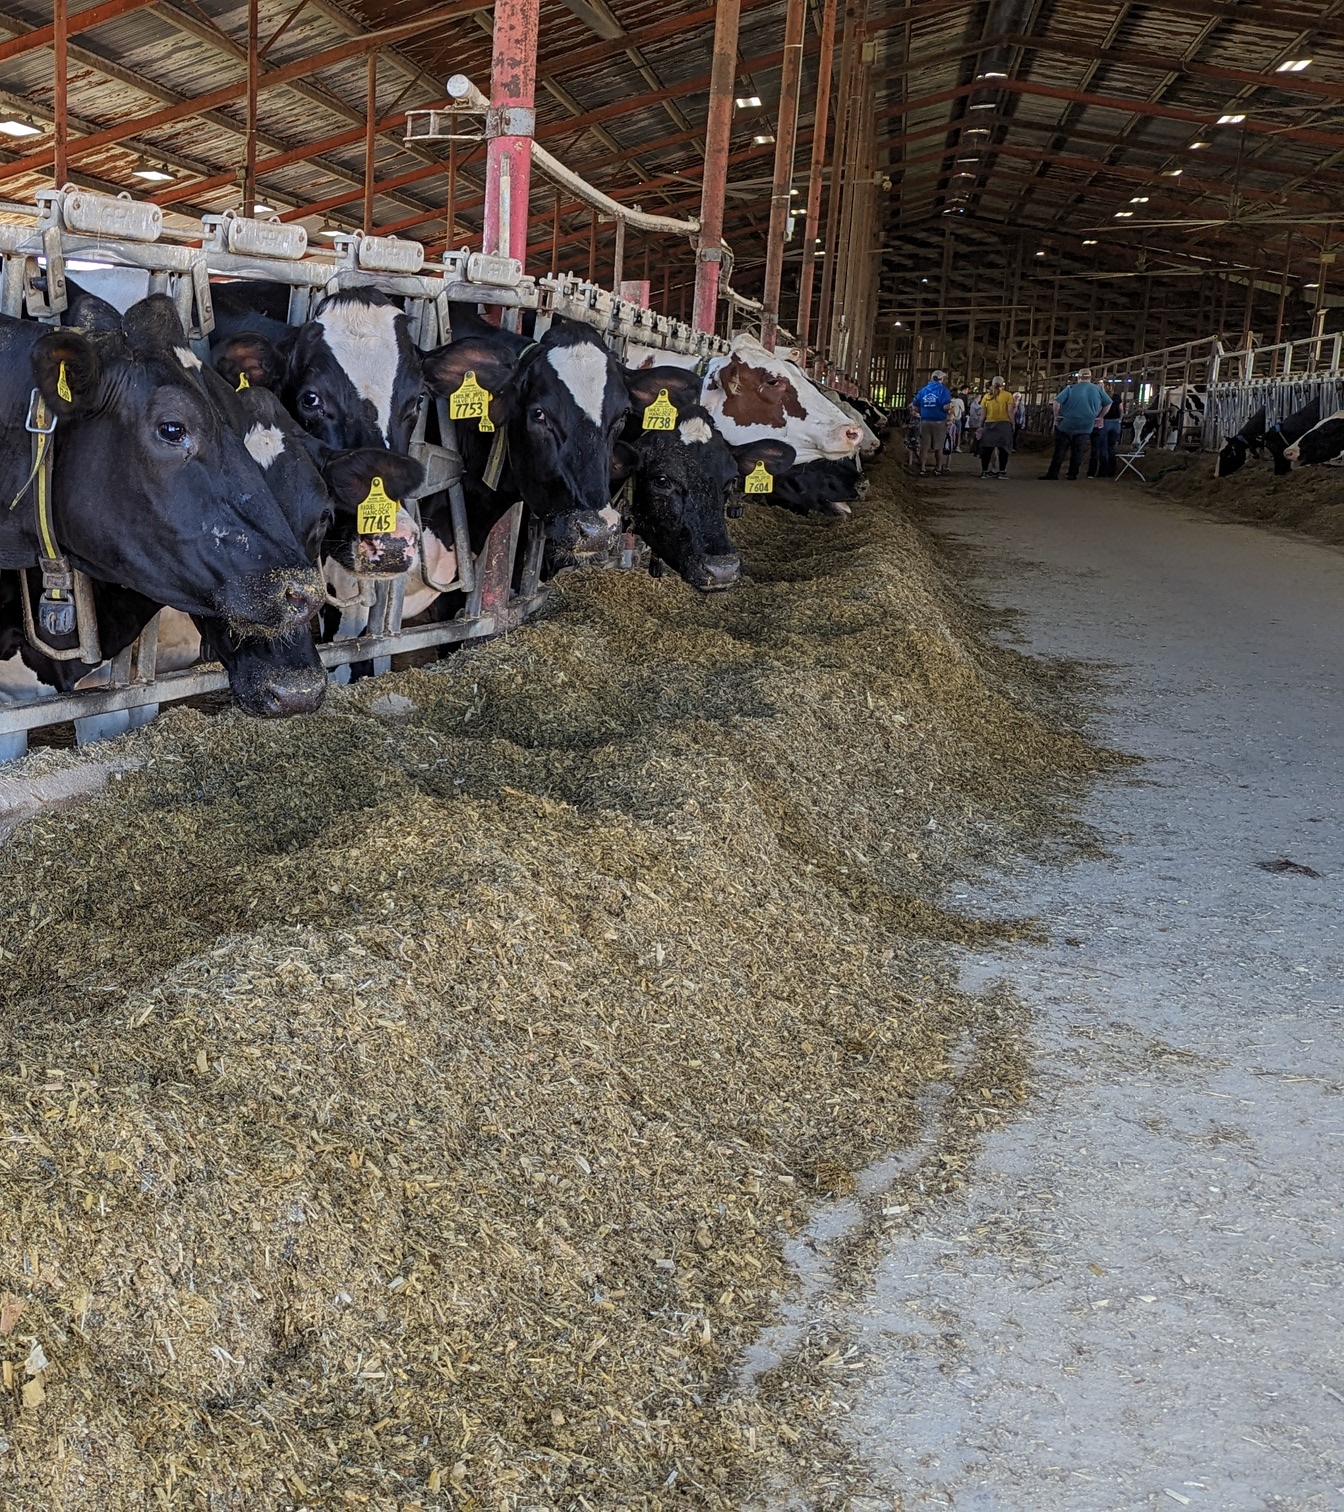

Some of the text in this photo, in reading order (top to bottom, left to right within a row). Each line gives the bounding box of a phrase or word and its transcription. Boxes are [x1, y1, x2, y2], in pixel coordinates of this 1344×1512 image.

[455, 401, 484, 418] 7753
[646, 416, 672, 429] 7738
[748, 482, 770, 493] 7604
[362, 514, 391, 533] 7745
